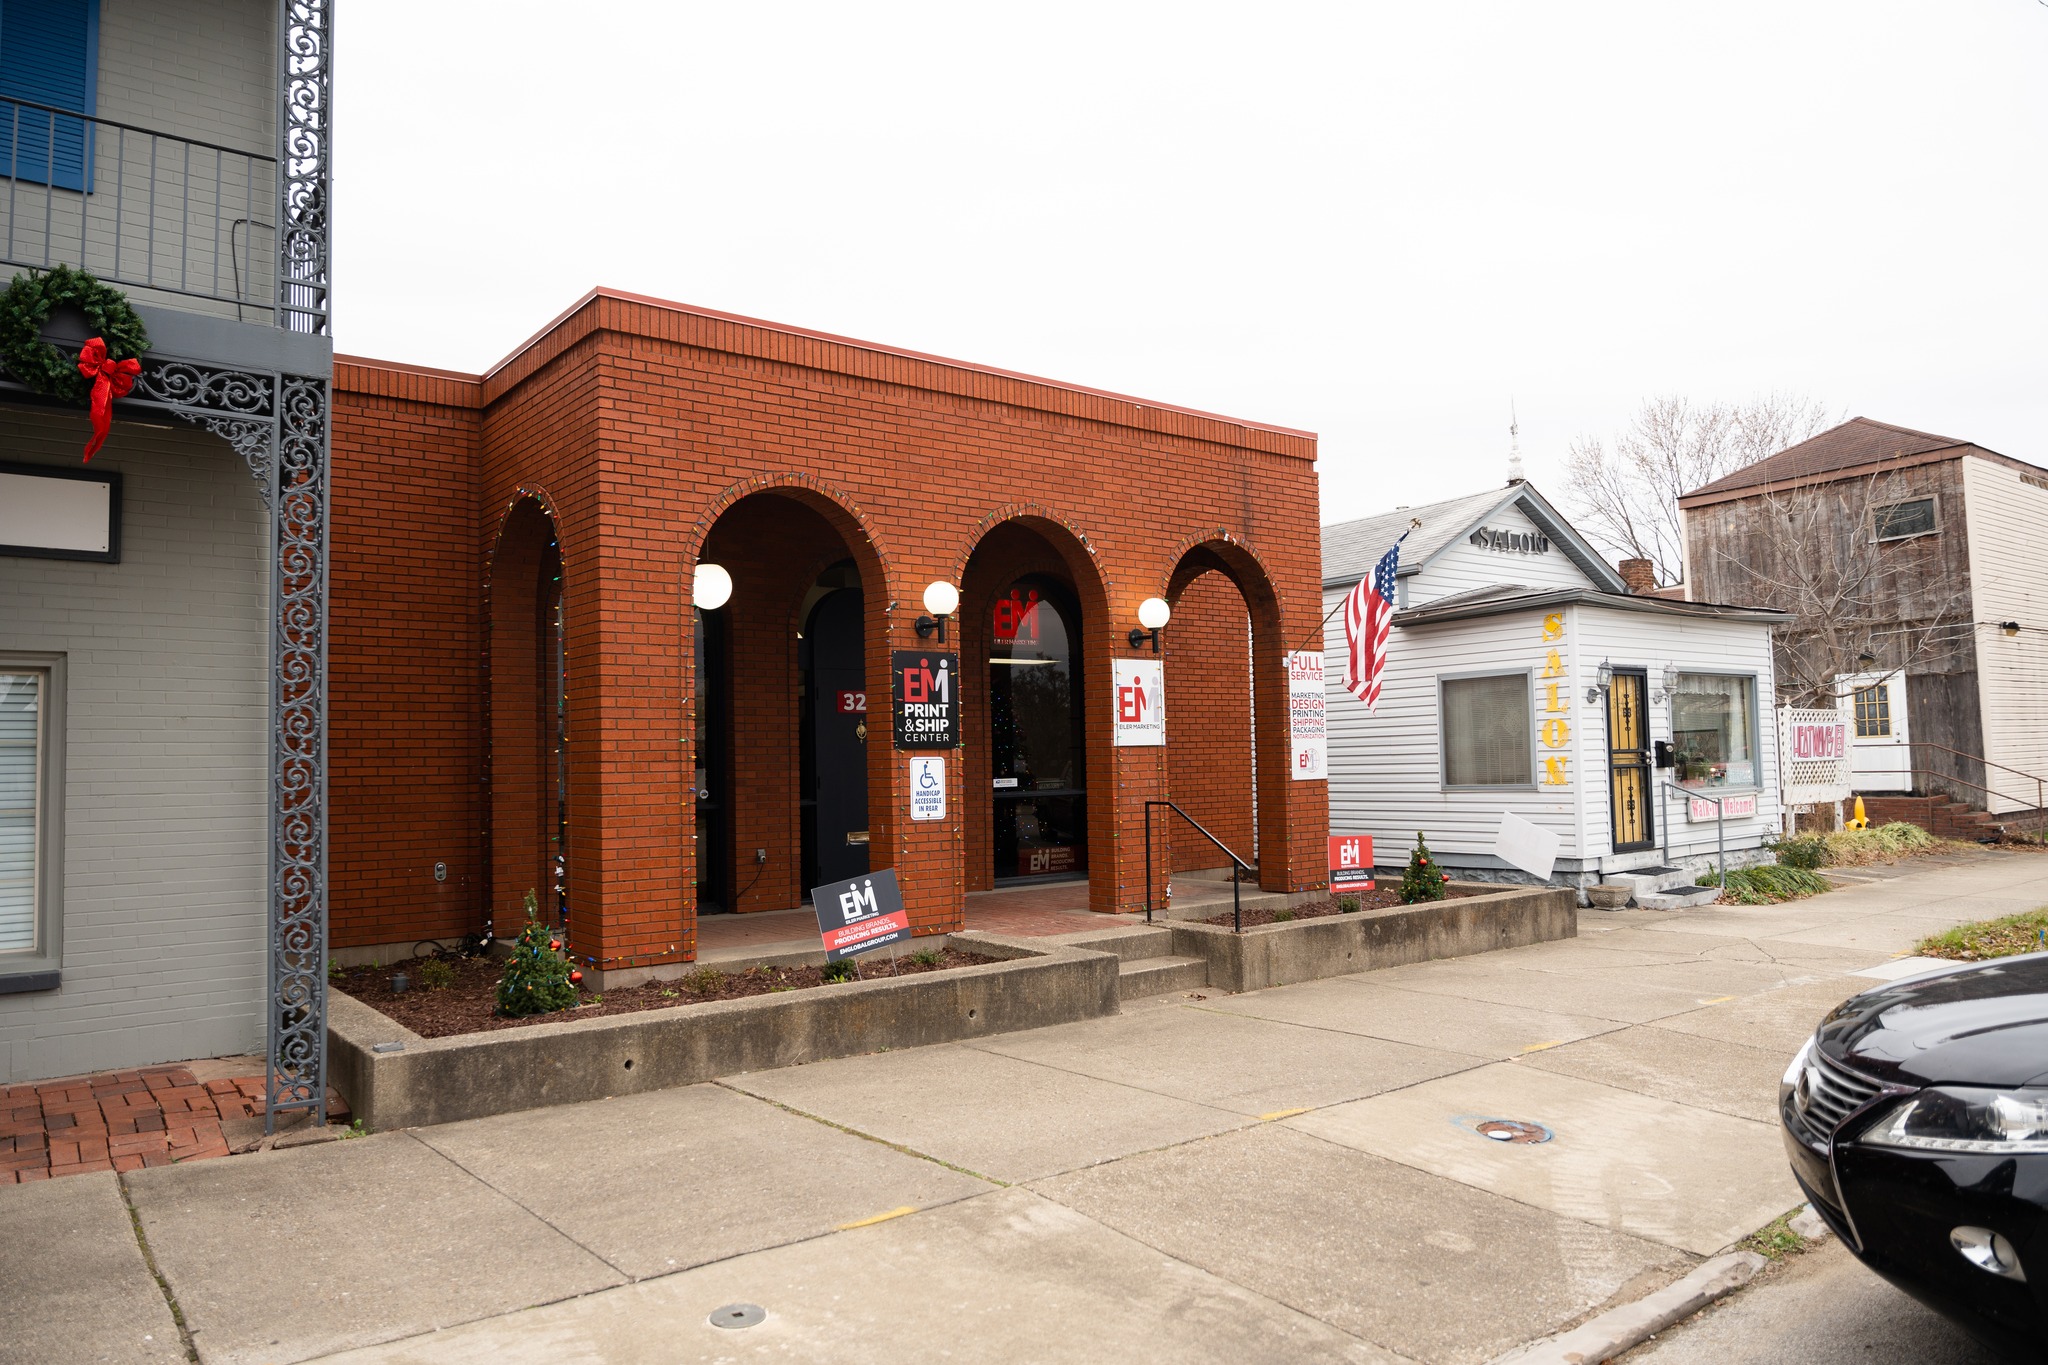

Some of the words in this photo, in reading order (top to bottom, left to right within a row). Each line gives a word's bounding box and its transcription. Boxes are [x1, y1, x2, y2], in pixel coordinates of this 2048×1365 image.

[1479, 526, 1544, 555] SALON
[1291, 656, 1323, 671] FULL
[1290, 671, 1324, 681] SERVICE
[1291, 699, 1325, 709] DESIGN
[1541, 612, 1570, 786] SALON
[904, 703, 949, 717] PRINT
[1292, 709, 1325, 718] PRINTING
[904, 718, 950, 732] &SHIP
[1292, 718, 1325, 727] SHIPPING
[1292, 726, 1325, 734] PACKAGING
[904, 733, 950, 742] CENTER
[914, 797, 942, 805] ACCESSIBLE
[1723, 796, 1754, 815] Welcome!
[856, 912, 879, 921] MARKETING
[838, 923, 865, 937] BUILDING
[865, 917, 890, 929] BRANDS.
[834, 930, 870, 946] PRODUCING
[871, 922, 898, 935] RESULTS.
